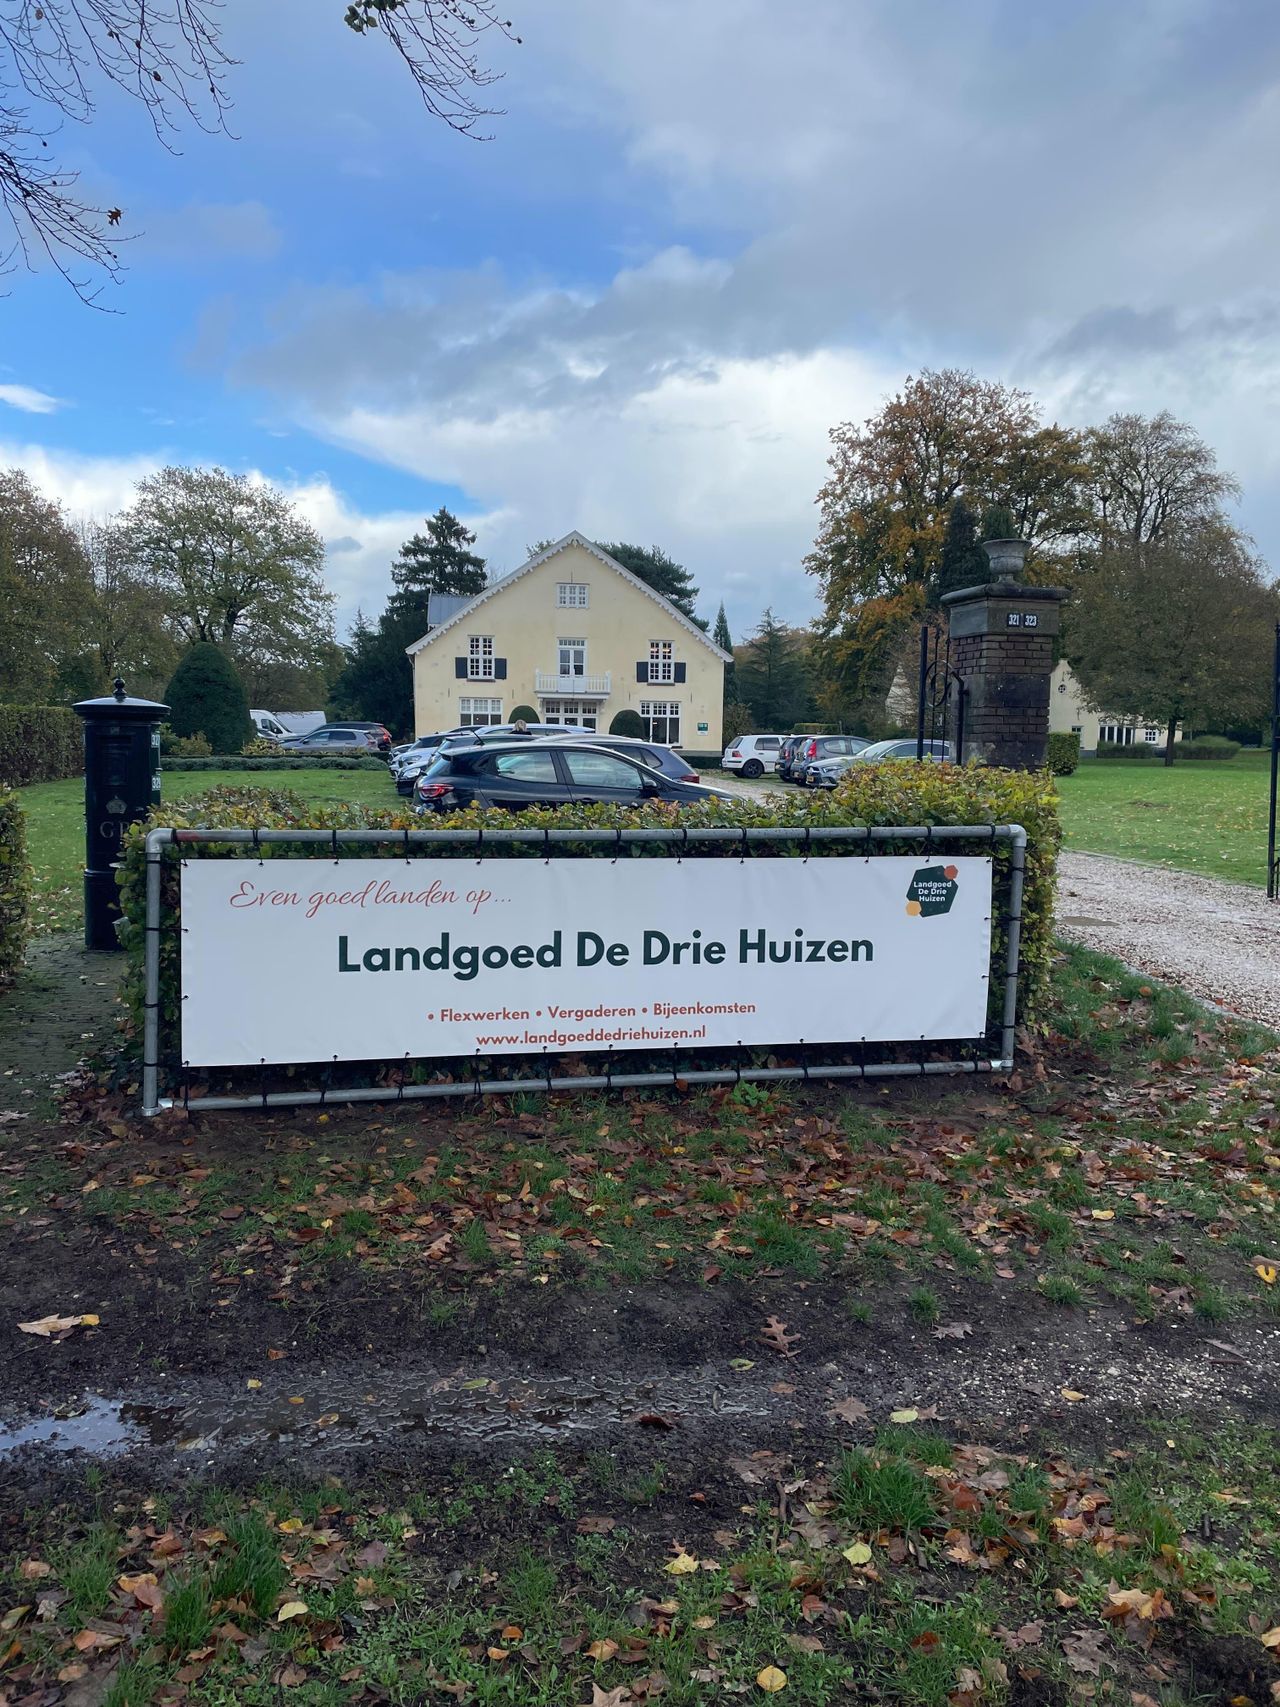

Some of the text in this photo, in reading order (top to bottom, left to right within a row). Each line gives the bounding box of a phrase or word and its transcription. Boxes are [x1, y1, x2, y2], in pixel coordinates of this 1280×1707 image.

[1008, 614, 1036, 626] 321 323
[230, 881, 302, 908] Even
[305, 880, 377, 918] goed
[374, 880, 460, 907] landen
[338, 928, 874, 981] Landgoed De Drie Huizen
[440, 1001, 756, 1022] Flexwerken Vergaderen Bijeenkomsten
[476, 1025, 706, 1046] www.landgoeddedriehuizen.nl
